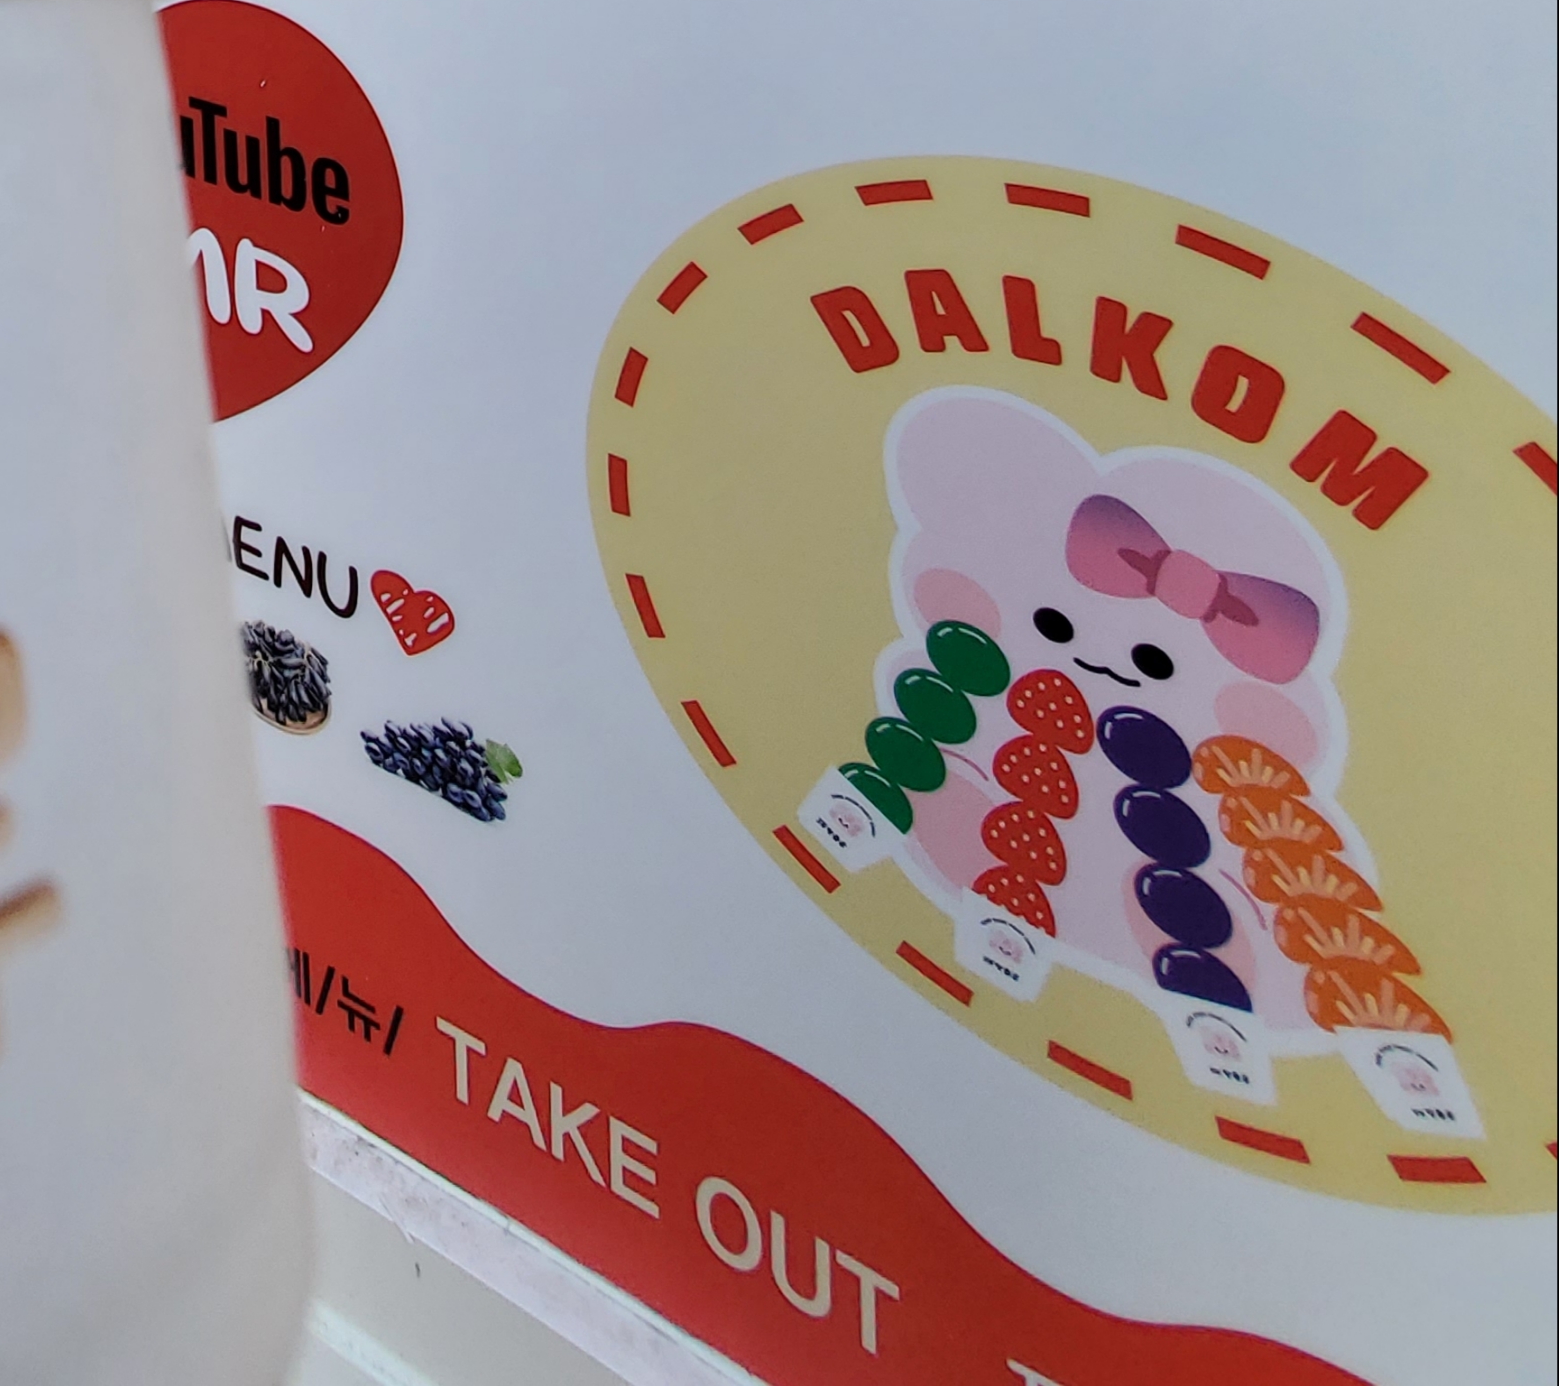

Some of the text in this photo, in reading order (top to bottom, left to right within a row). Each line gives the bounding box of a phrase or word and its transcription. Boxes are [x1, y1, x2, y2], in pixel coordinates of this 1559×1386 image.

[812, 269, 1430, 531] DALKOM
[227, 514, 360, 620] ENU
[435, 1015, 662, 1220] TAKE
[694, 1174, 902, 1357] OUT
